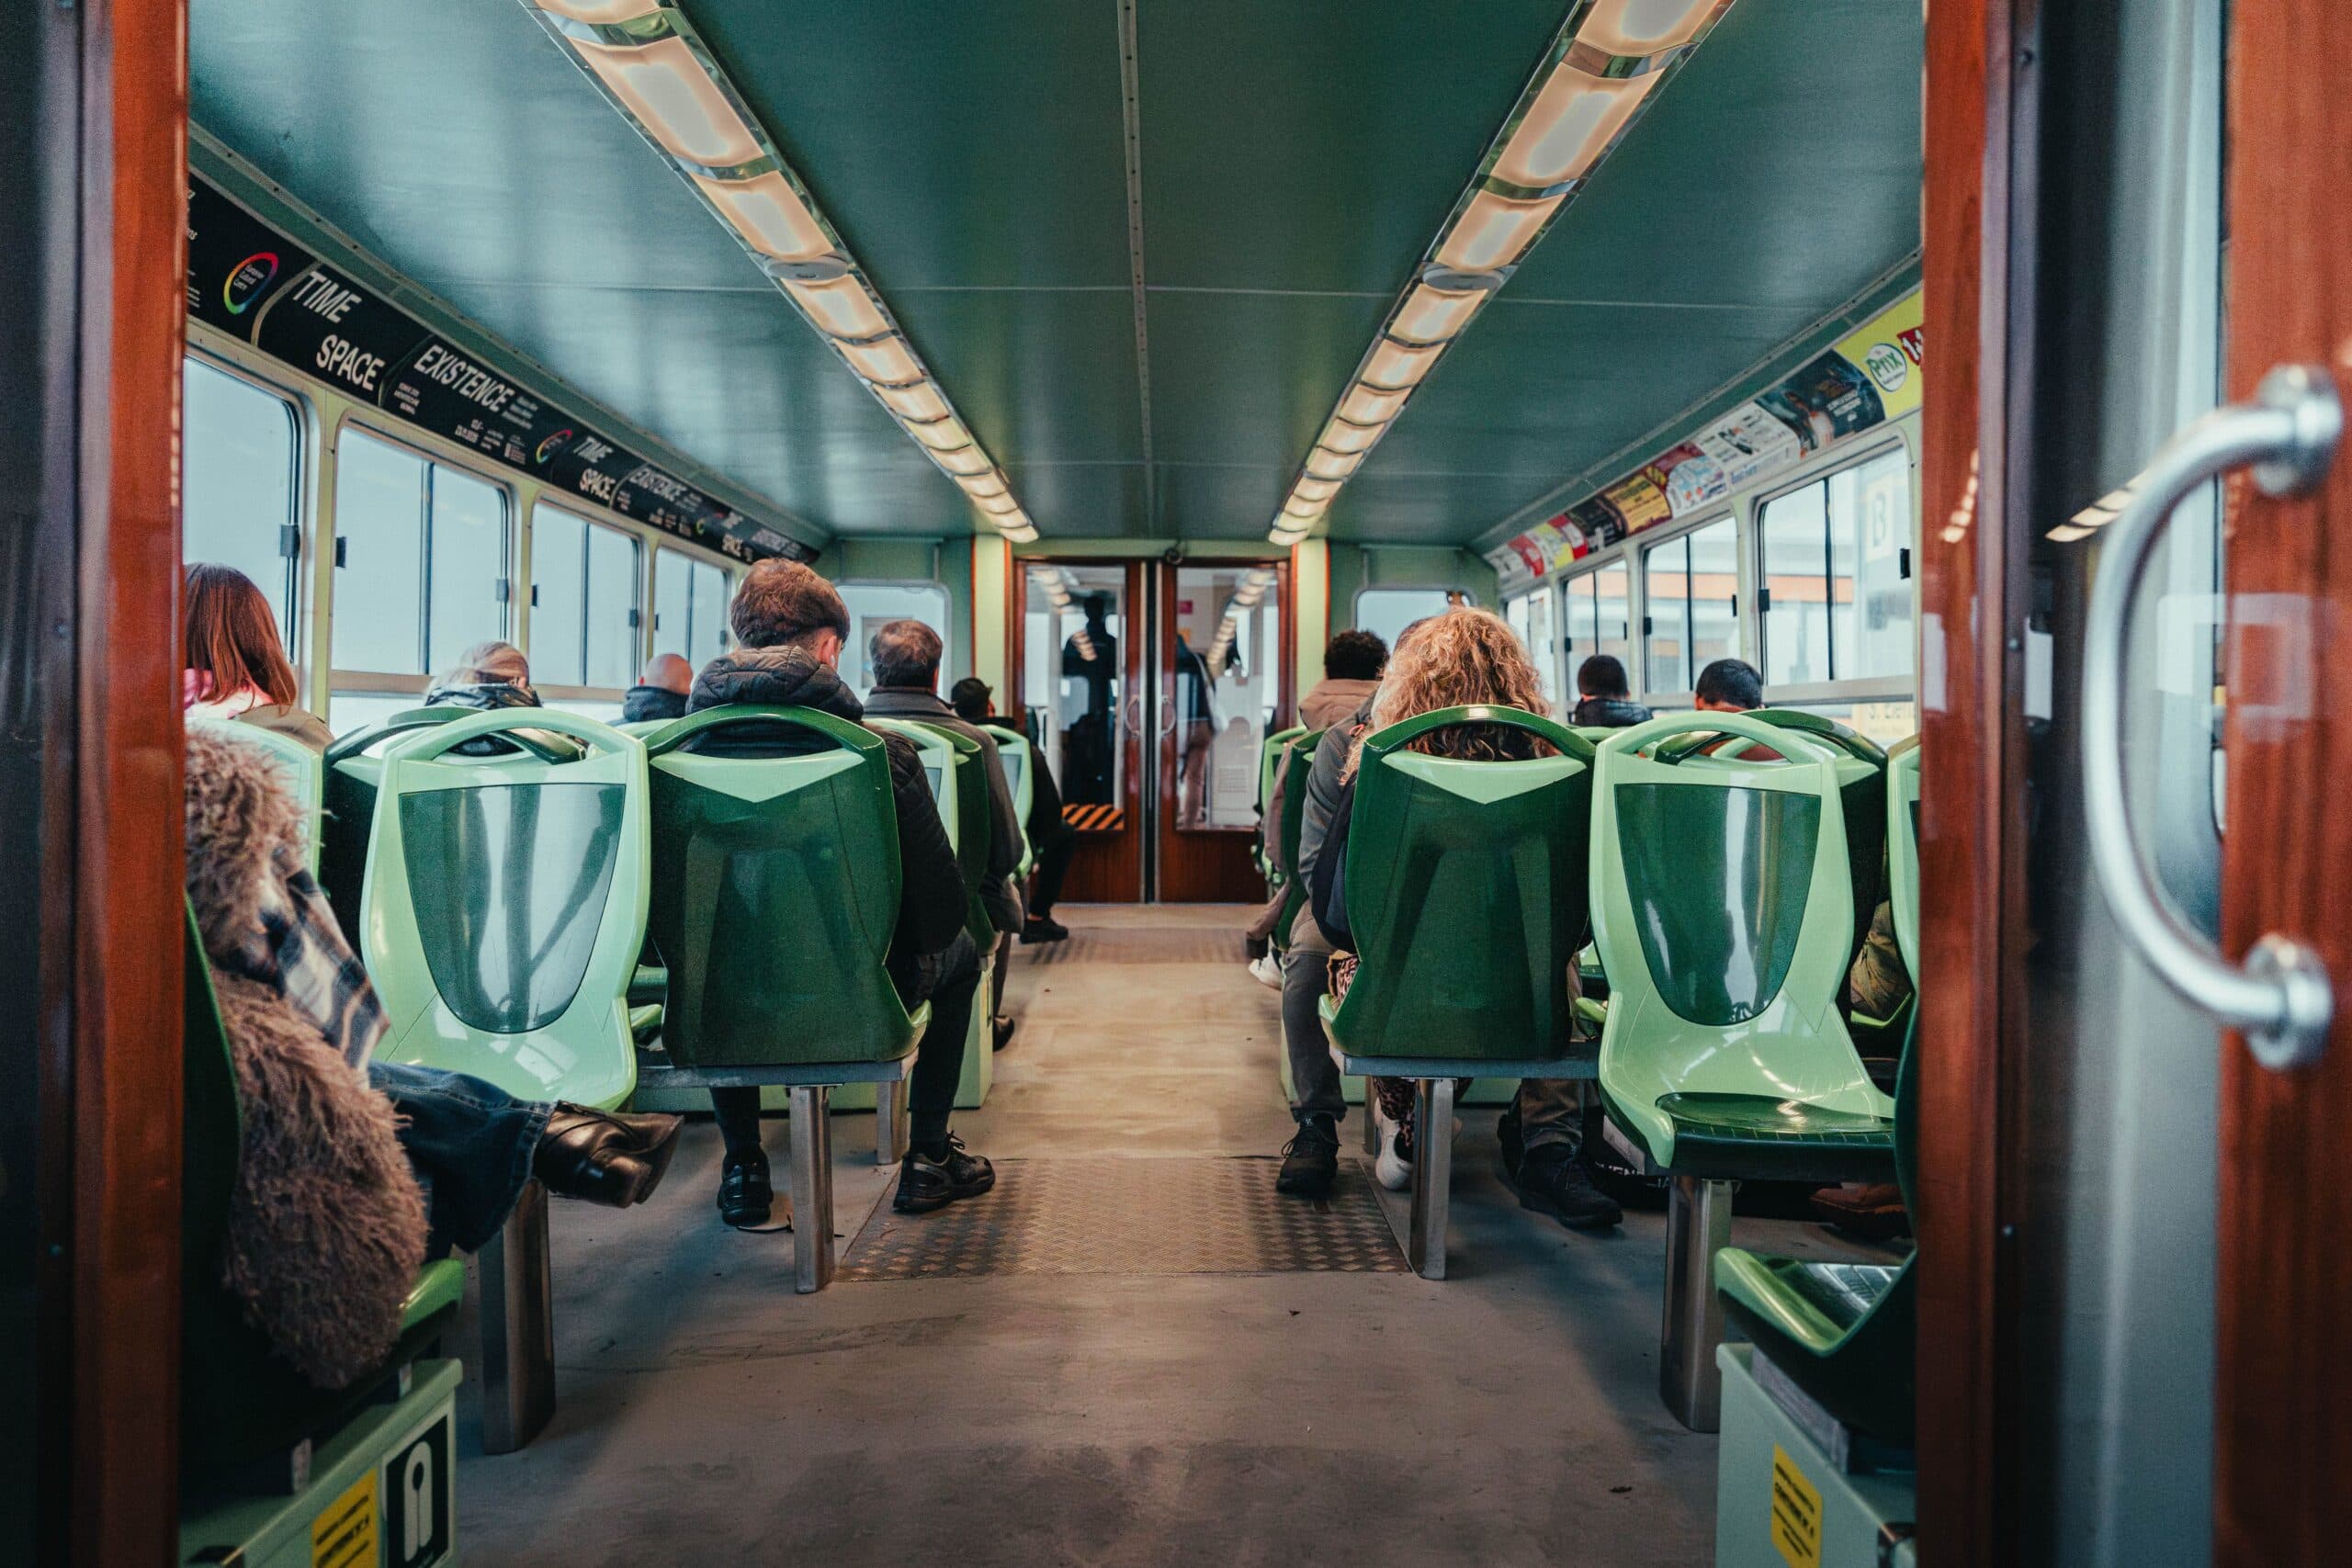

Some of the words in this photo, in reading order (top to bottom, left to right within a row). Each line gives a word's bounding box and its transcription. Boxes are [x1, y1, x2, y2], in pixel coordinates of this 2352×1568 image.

[292, 270, 363, 323] TIME
[315, 333, 386, 391] SPACE
[413, 344, 515, 412] EXISTENCE
[579, 468, 616, 501] SPACE
